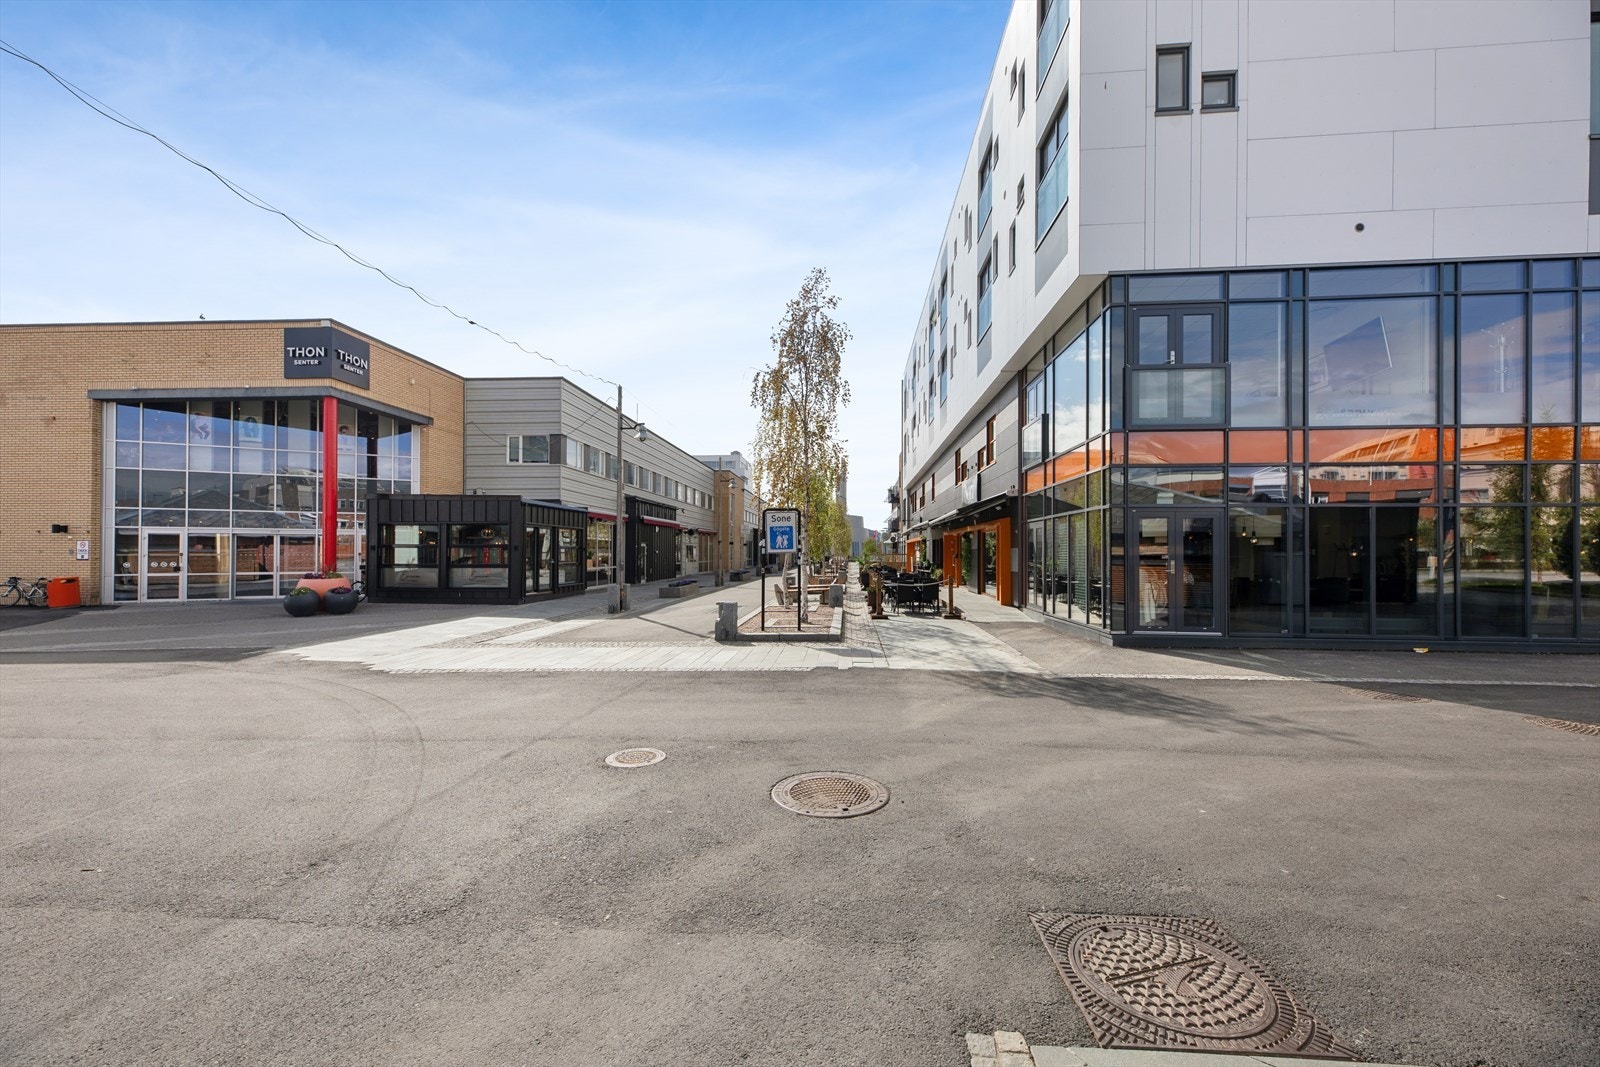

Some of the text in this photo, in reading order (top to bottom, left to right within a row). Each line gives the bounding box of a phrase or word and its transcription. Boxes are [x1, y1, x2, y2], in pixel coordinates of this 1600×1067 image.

[287, 347, 325, 357] THON
[338, 349, 368, 370] THON
[343, 364, 364, 376] SENTER
